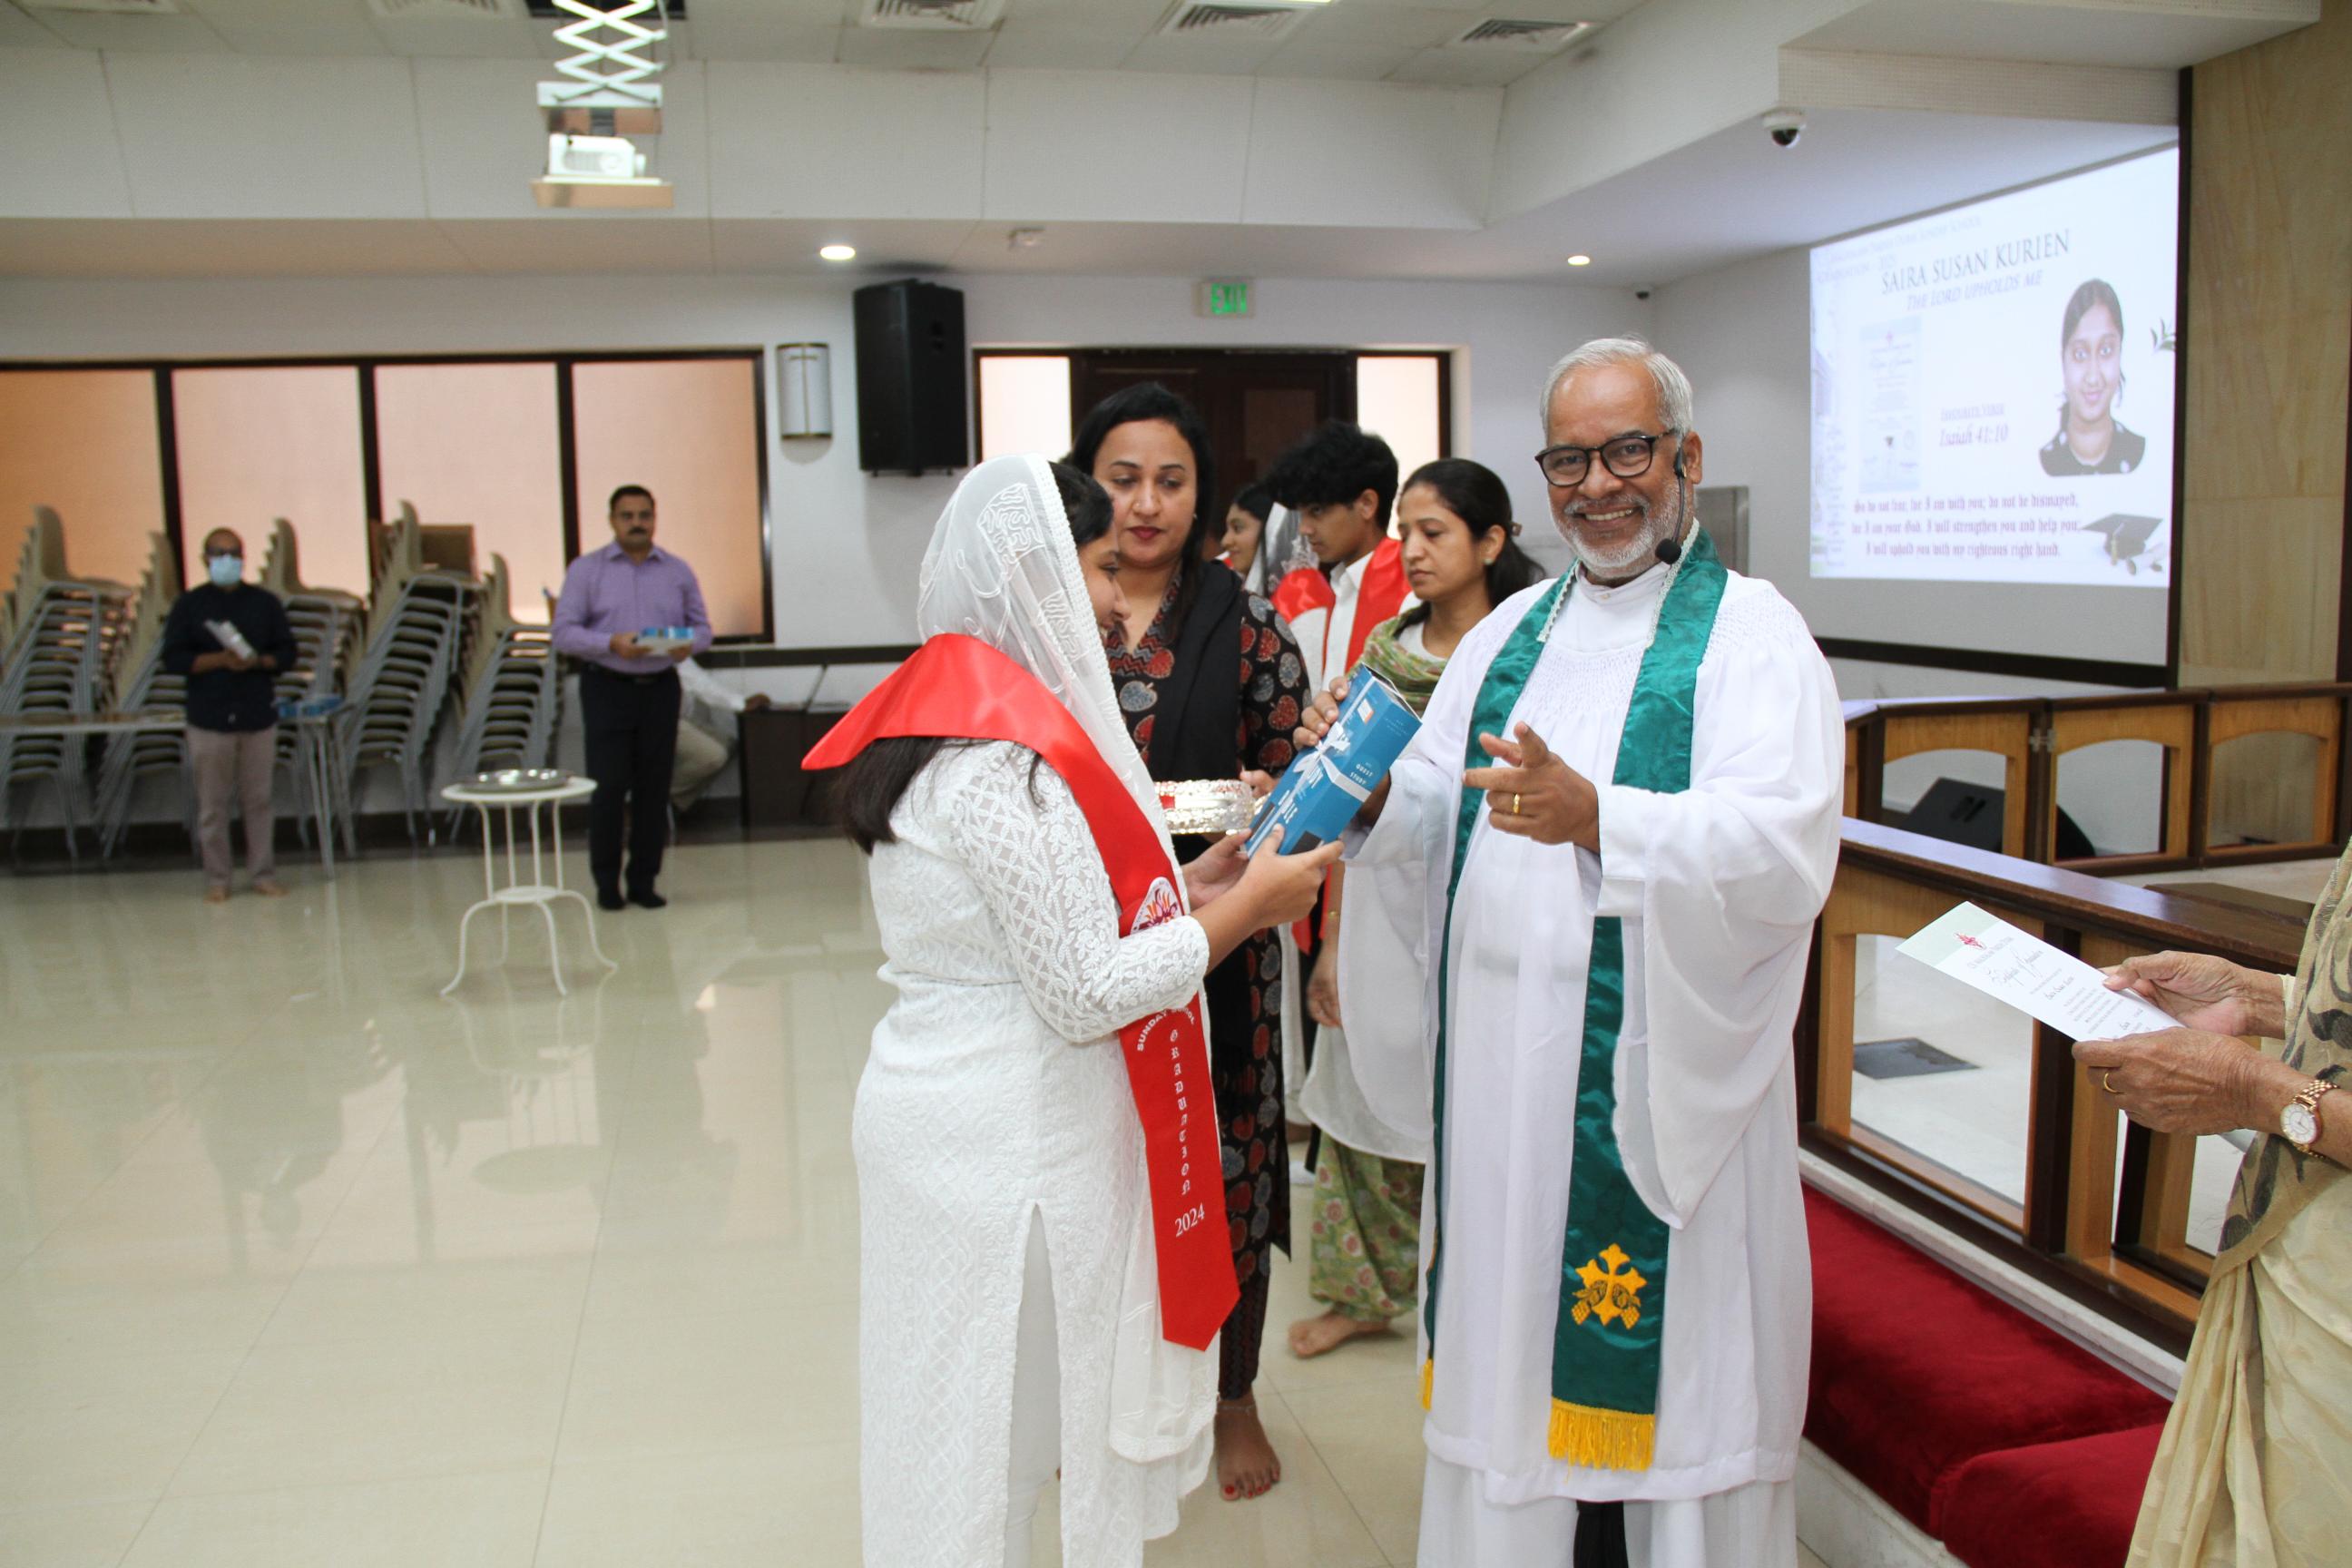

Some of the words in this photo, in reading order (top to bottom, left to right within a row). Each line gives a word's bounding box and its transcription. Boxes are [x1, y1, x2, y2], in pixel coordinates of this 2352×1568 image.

[1881, 265, 1926, 296] SAIRA
[1932, 249, 1988, 284] SUSAN
[1995, 228, 2070, 270] KURIEN
[1211, 283, 1247, 314] EXIT
[1906, 291, 1927, 312] THE
[1930, 284, 1962, 308] LORD
[1964, 274, 2019, 300] UPHOLDS
[2023, 270, 2043, 288] ME
[1939, 423, 1974, 447] Isaiah
[1975, 423, 2009, 444] 41:10
[1137, 1010, 1167, 1052] SUNDAY
[1175, 1201, 1206, 1238] 2024
